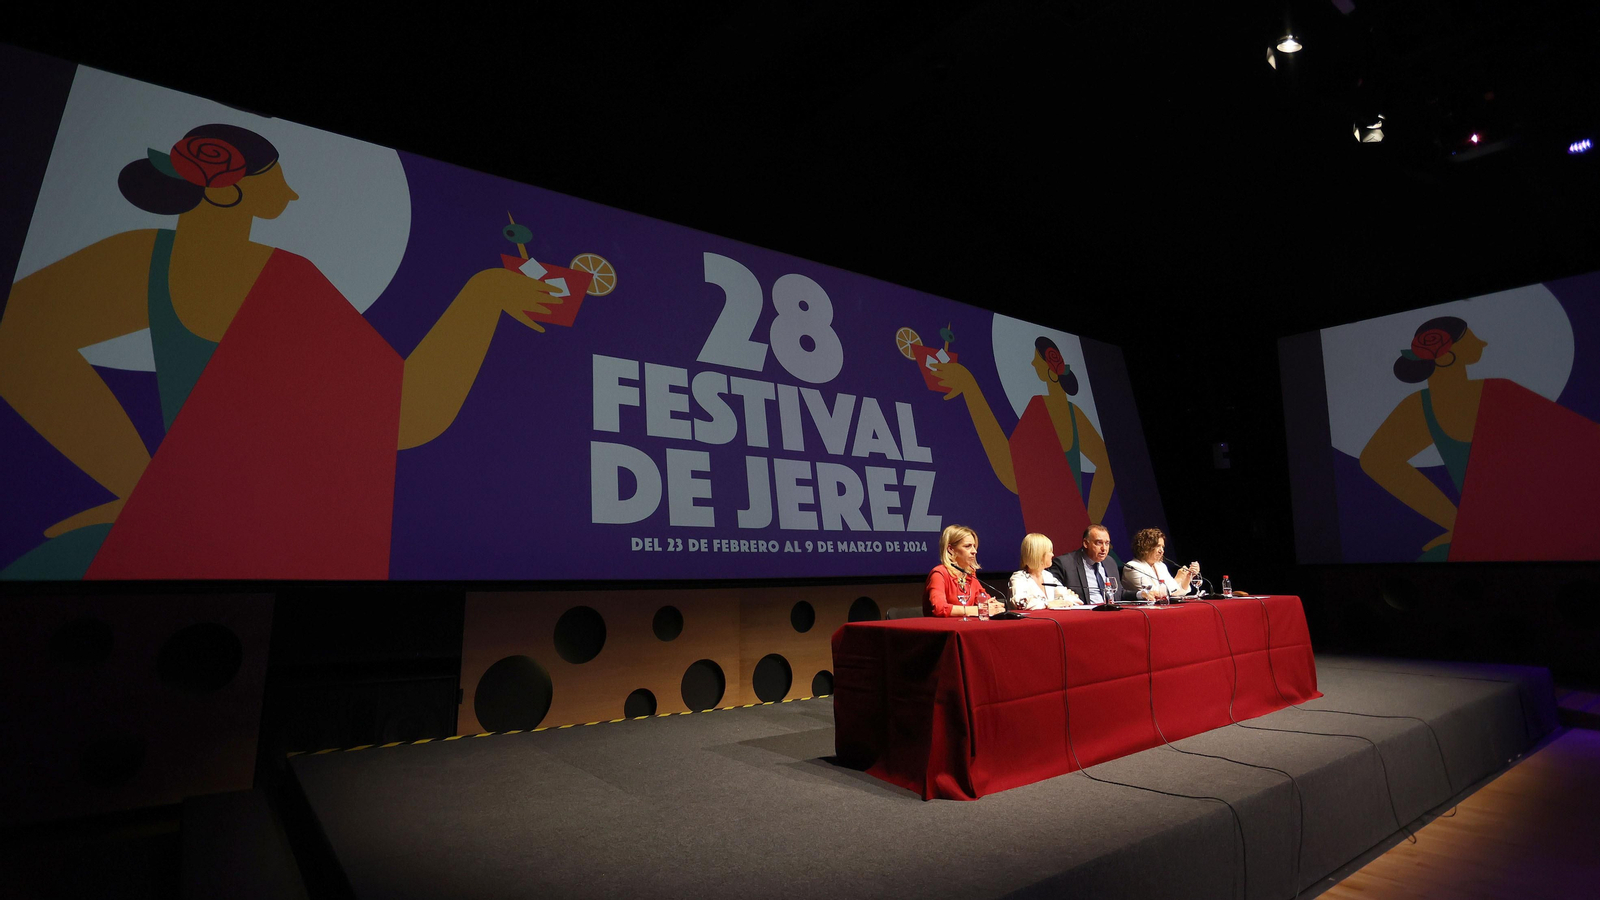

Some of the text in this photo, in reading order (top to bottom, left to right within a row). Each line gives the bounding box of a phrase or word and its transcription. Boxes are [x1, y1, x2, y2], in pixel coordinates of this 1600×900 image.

[696, 252, 844, 384] 28
[592, 354, 933, 464] FESTIVAL
[590, 440, 942, 532] DE JEREZ
[631, 537, 928, 553] DEL 23 DE FEBRERO AL 9 DE MARZO DE 2024
